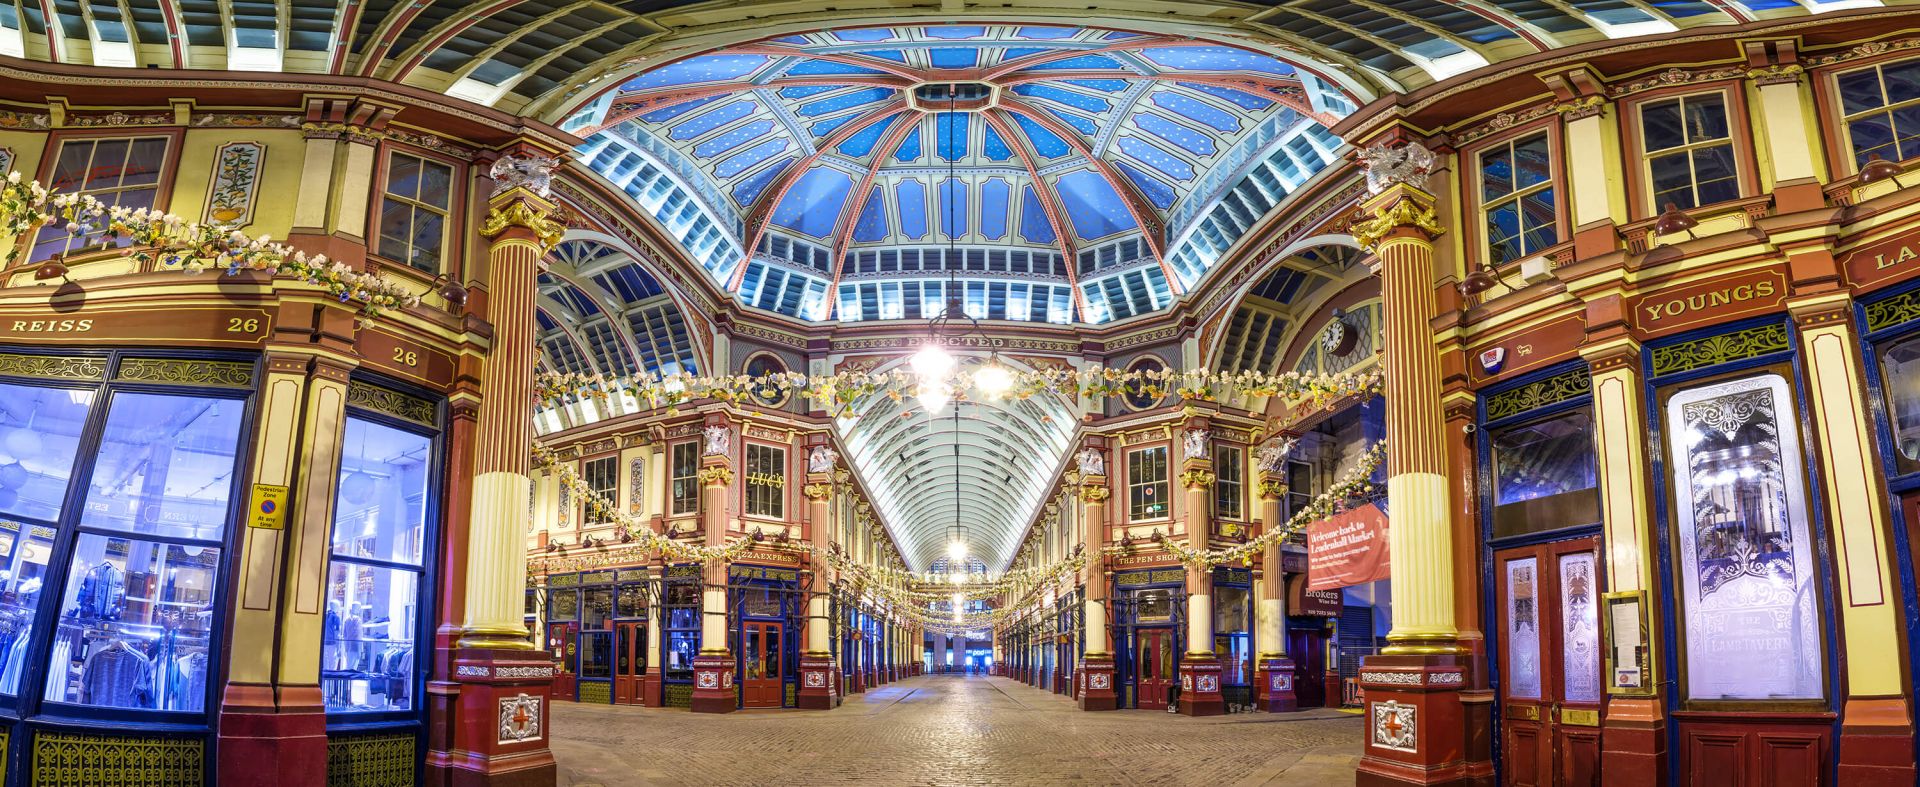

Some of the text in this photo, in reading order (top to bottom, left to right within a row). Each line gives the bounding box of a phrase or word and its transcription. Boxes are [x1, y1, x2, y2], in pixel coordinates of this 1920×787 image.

[617, 222, 681, 283] MARKET
[1646, 280, 1775, 321] YOUNGS
[11, 319, 94, 332] REISS
[227, 317, 259, 333] 26
[392, 346, 418, 367] 26
[1311, 522, 1365, 543] Welcome back to
[1311, 529, 1375, 554] Leadenhall Market
[1156, 554, 1178, 562] SHOP
